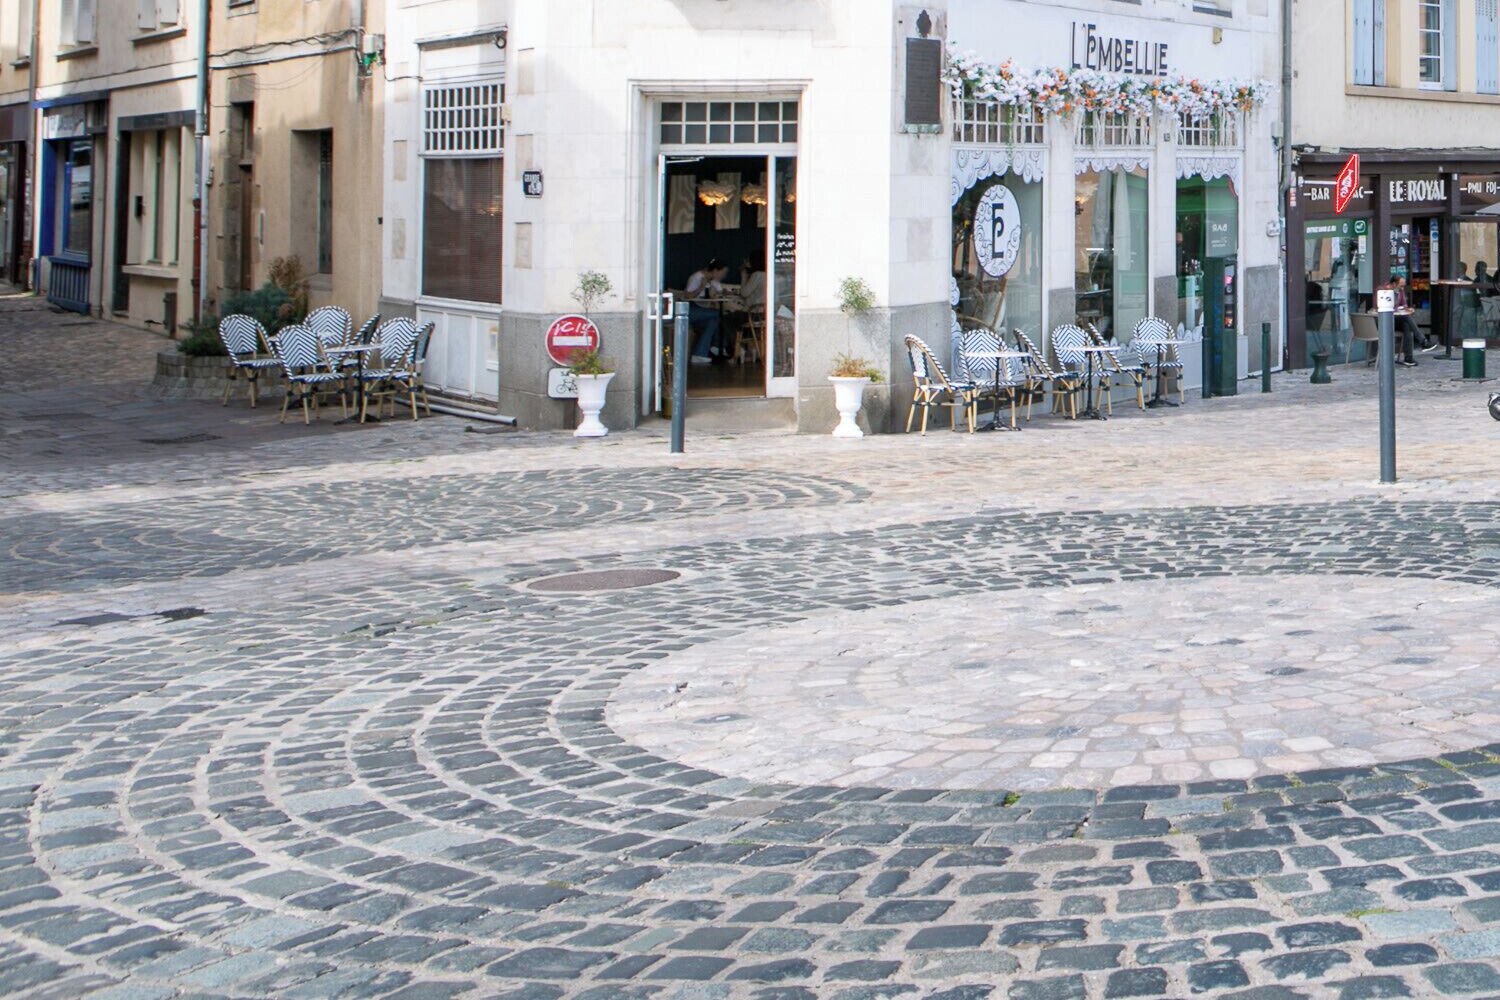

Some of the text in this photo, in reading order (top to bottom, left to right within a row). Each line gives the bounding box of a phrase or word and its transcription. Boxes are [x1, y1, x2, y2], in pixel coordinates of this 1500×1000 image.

[1311, 187, 1330, 201] BAR
[1390, 180, 1404, 202] LE
[1407, 179, 1448, 202] ROYAL
